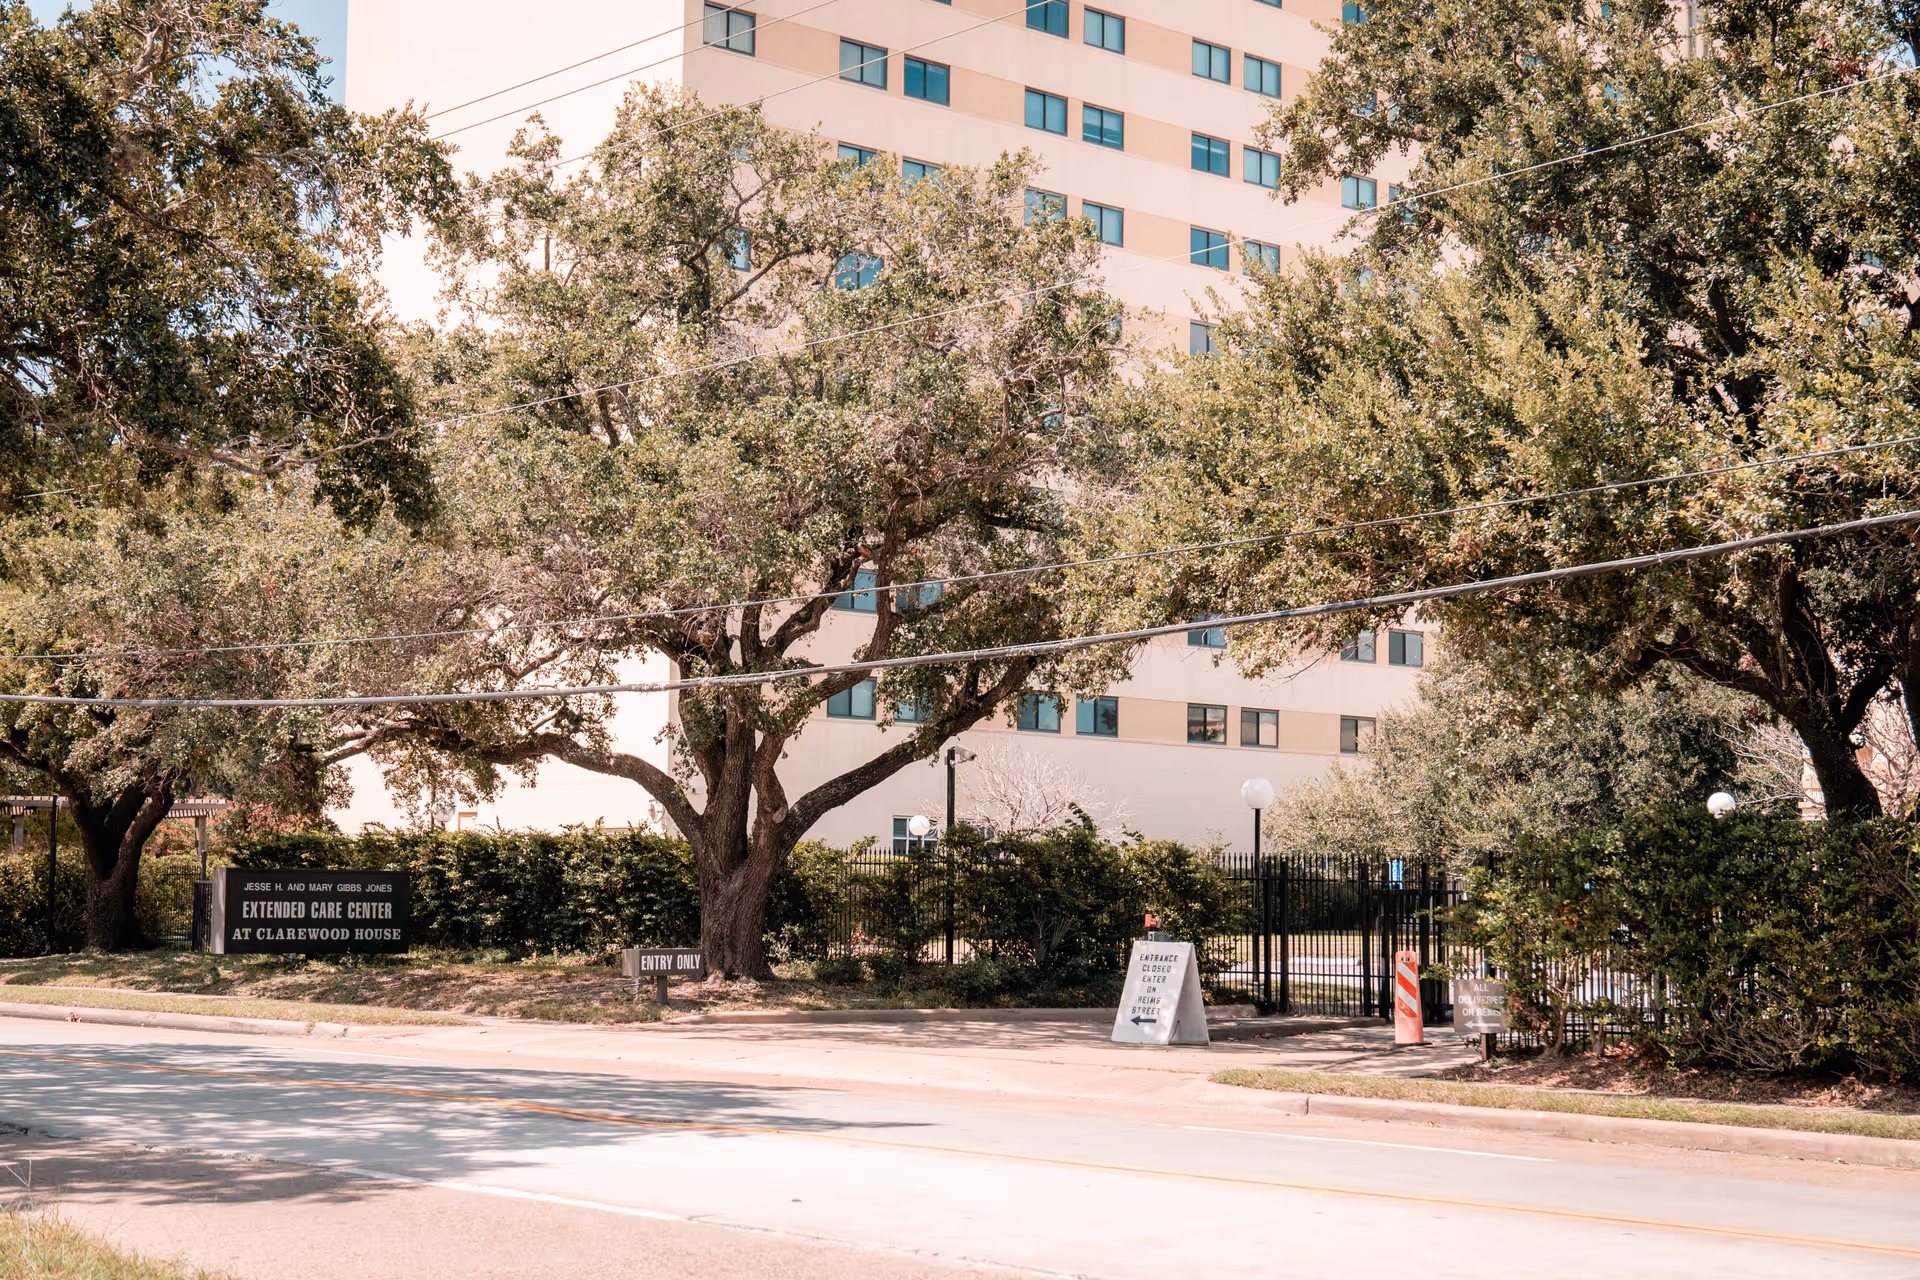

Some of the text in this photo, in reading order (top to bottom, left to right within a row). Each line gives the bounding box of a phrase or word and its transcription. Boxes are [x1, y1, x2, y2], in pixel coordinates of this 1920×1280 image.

[244, 882, 392, 892] JESSE H. AND MARY GIBBS JONES
[242, 901, 392, 919] EXTENDED CARE CENTER
[232, 928, 401, 940] AT CLAREWOOD HOUSE
[641, 954, 700, 970] ENTRY ONLY
[1140, 954, 1178, 962] ENTRANCE
[1142, 964, 1172, 972] CLOSED
[1142, 975, 1166, 983] ENTER
[1474, 984, 1489, 992] ALL
[1137, 996, 1161, 1004] REIMS
[1132, 1006, 1160, 1015] STREET
[1462, 1008, 1474, 1016] ON
